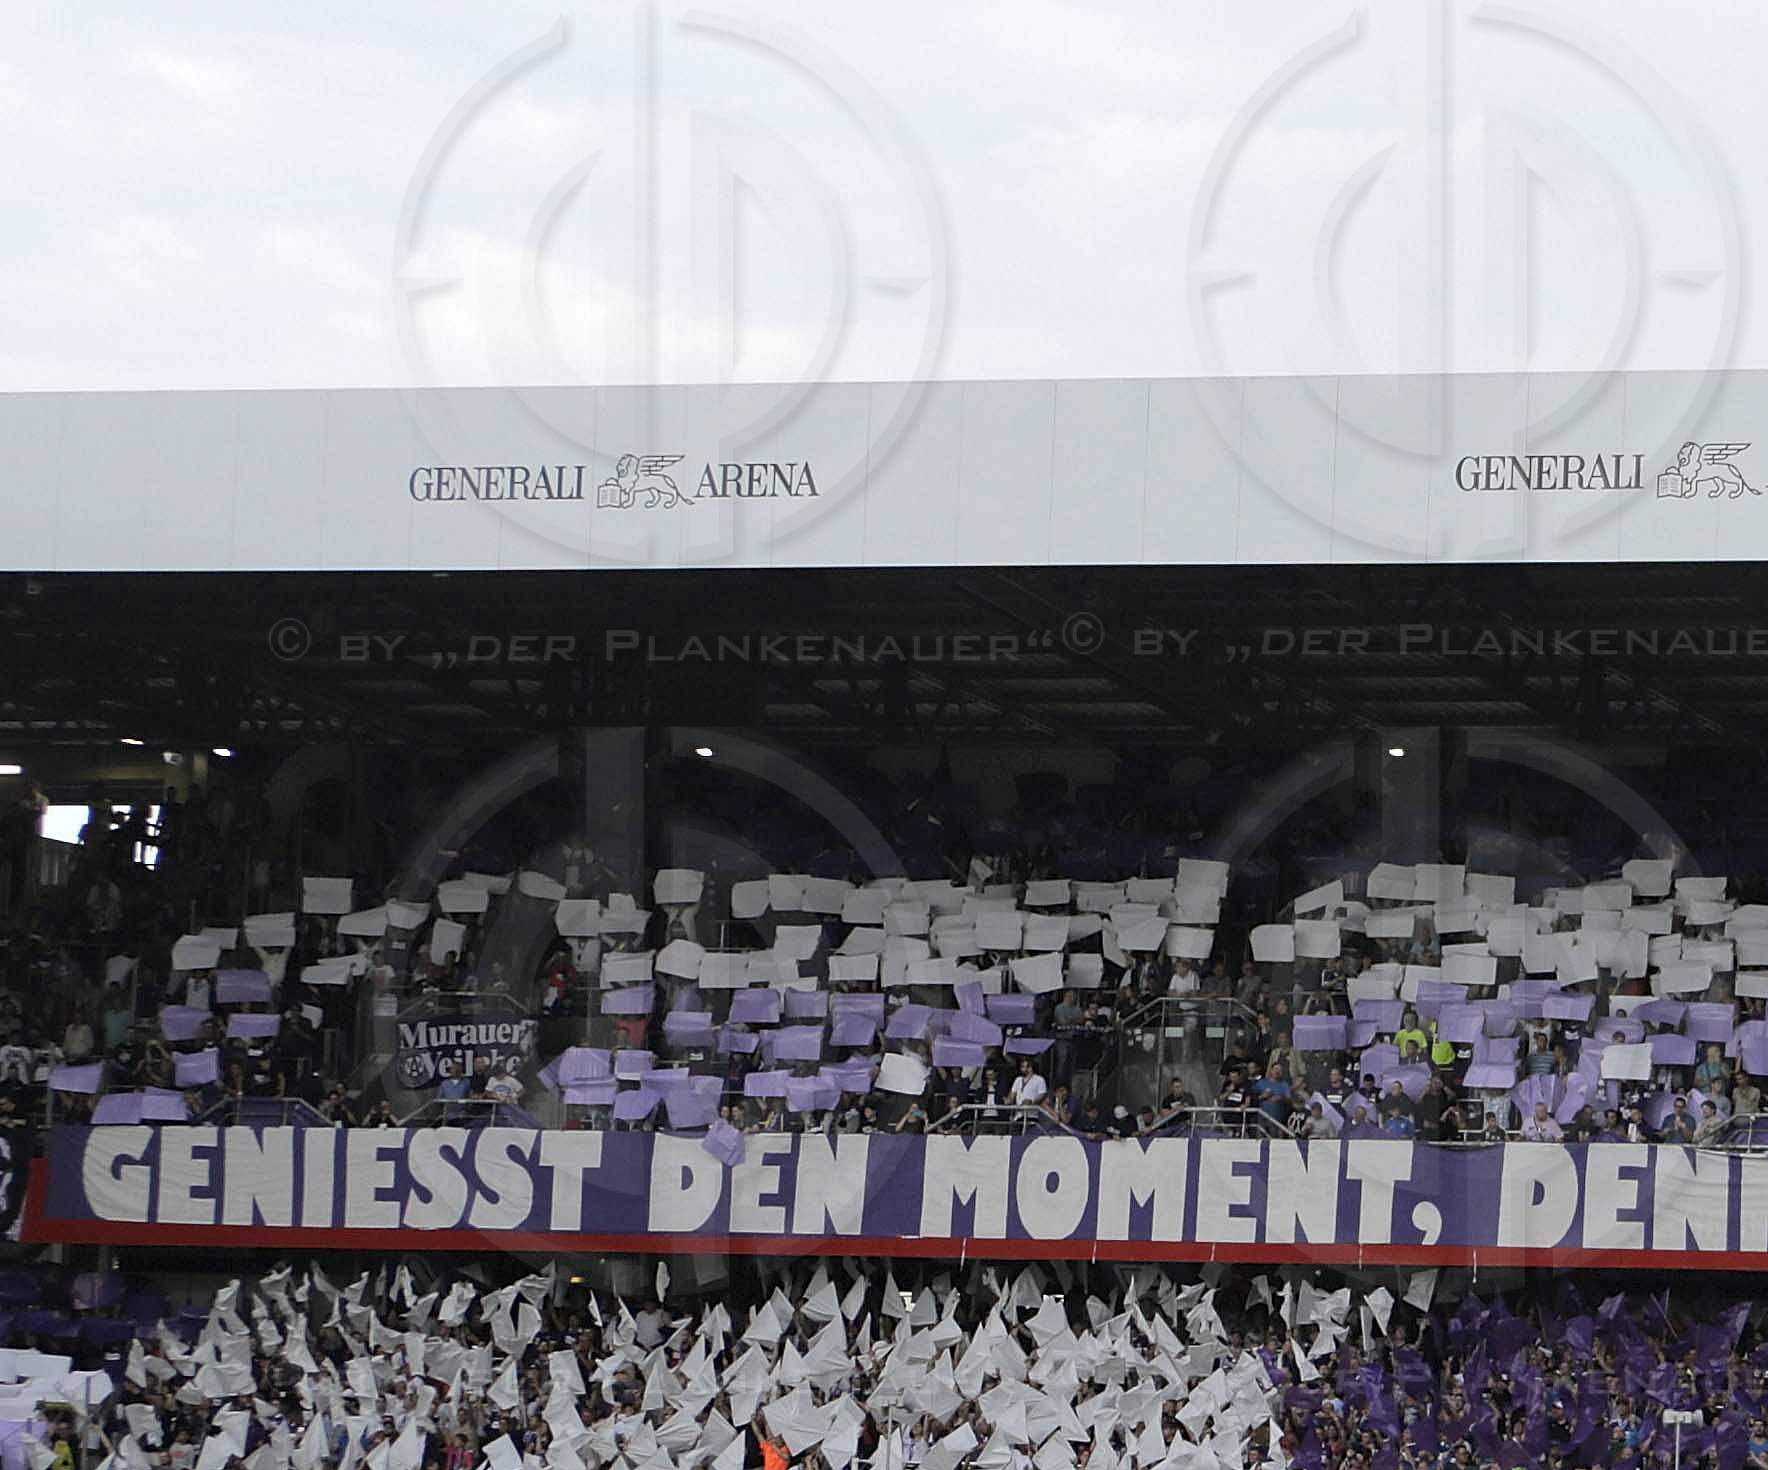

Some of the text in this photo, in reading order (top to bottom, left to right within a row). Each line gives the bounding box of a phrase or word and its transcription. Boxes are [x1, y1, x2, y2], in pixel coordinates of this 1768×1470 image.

[408, 461, 820, 502] GENERALI ARENA
[1455, 453, 1645, 492] GENERALI
[398, 1019, 531, 1049] Murauer
[82, 1125, 603, 1233] GENIESST
[647, 1132, 869, 1236] DEN
[919, 1135, 1443, 1247] MOMENT,
